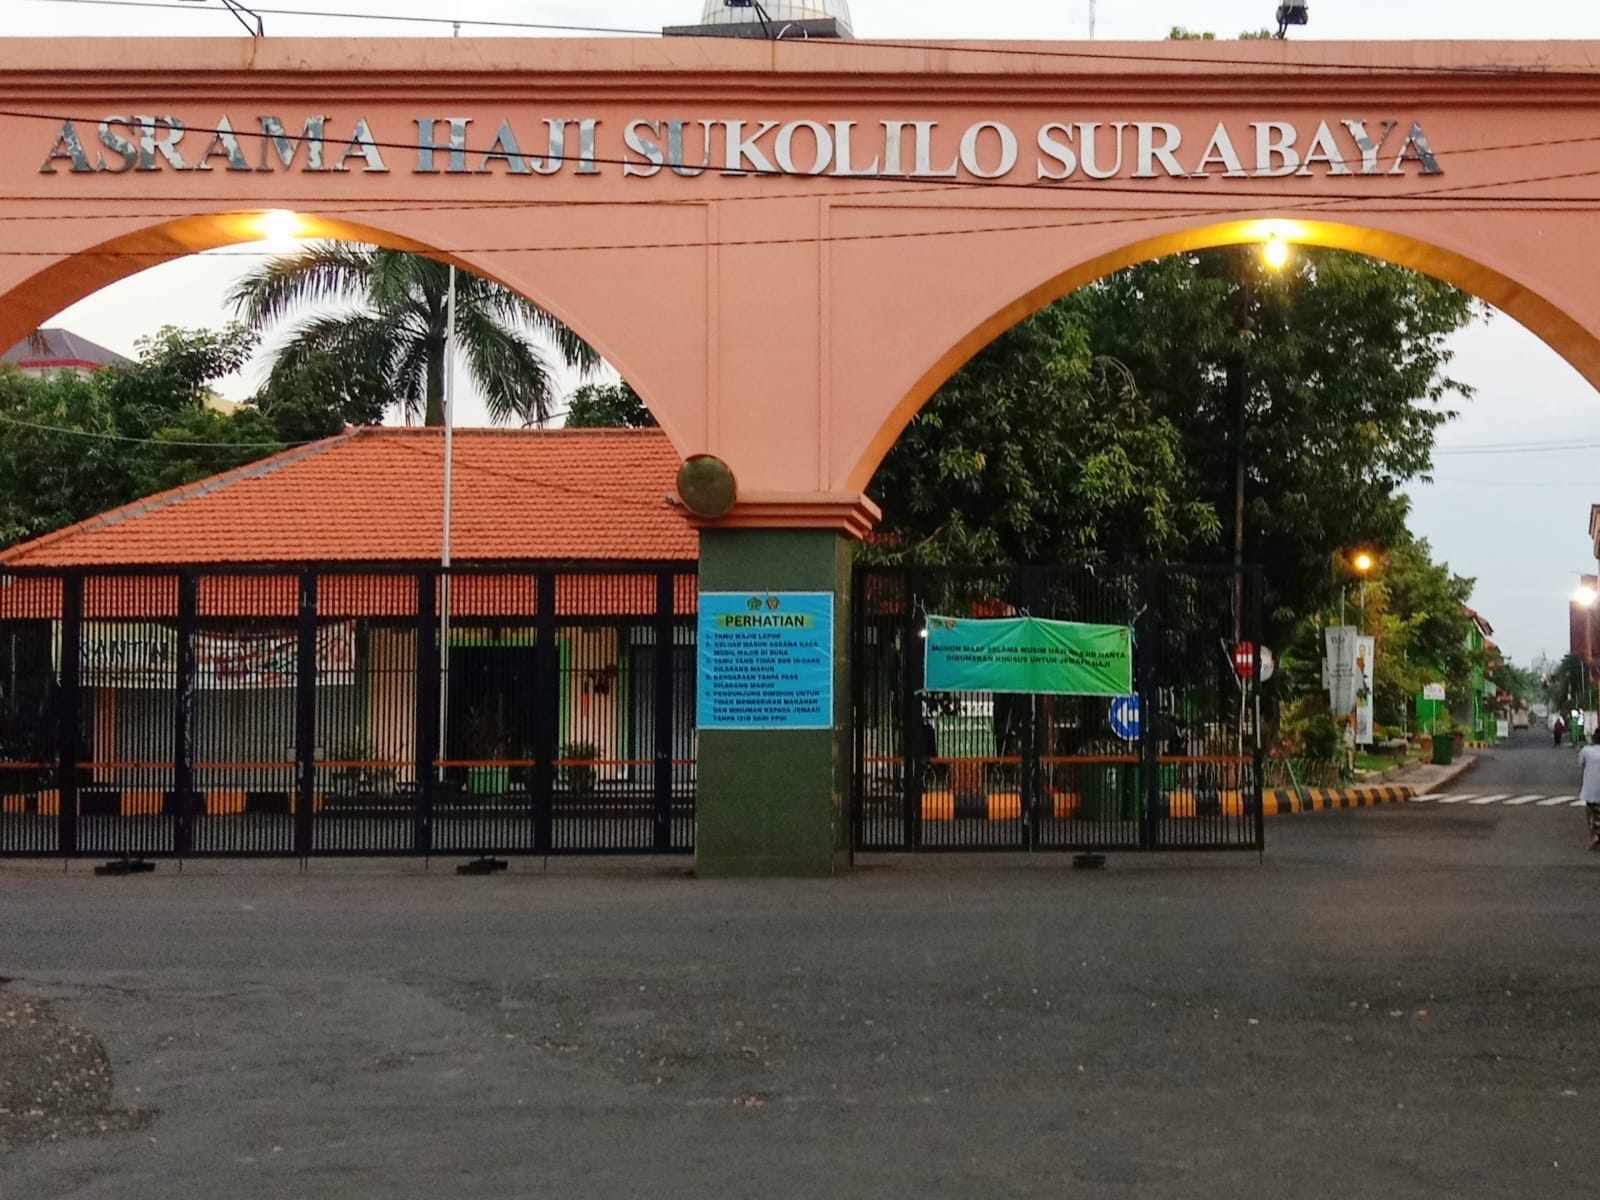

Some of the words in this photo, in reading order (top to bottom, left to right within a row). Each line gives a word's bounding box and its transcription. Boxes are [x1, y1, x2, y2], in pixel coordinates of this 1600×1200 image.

[39, 113, 389, 174] ASRAMA
[411, 116, 602, 176] HAJI
[622, 118, 1019, 179] SUKOLILO
[1036, 120, 1444, 181] SURABAYA
[725, 615, 805, 628] PERHATIAN
